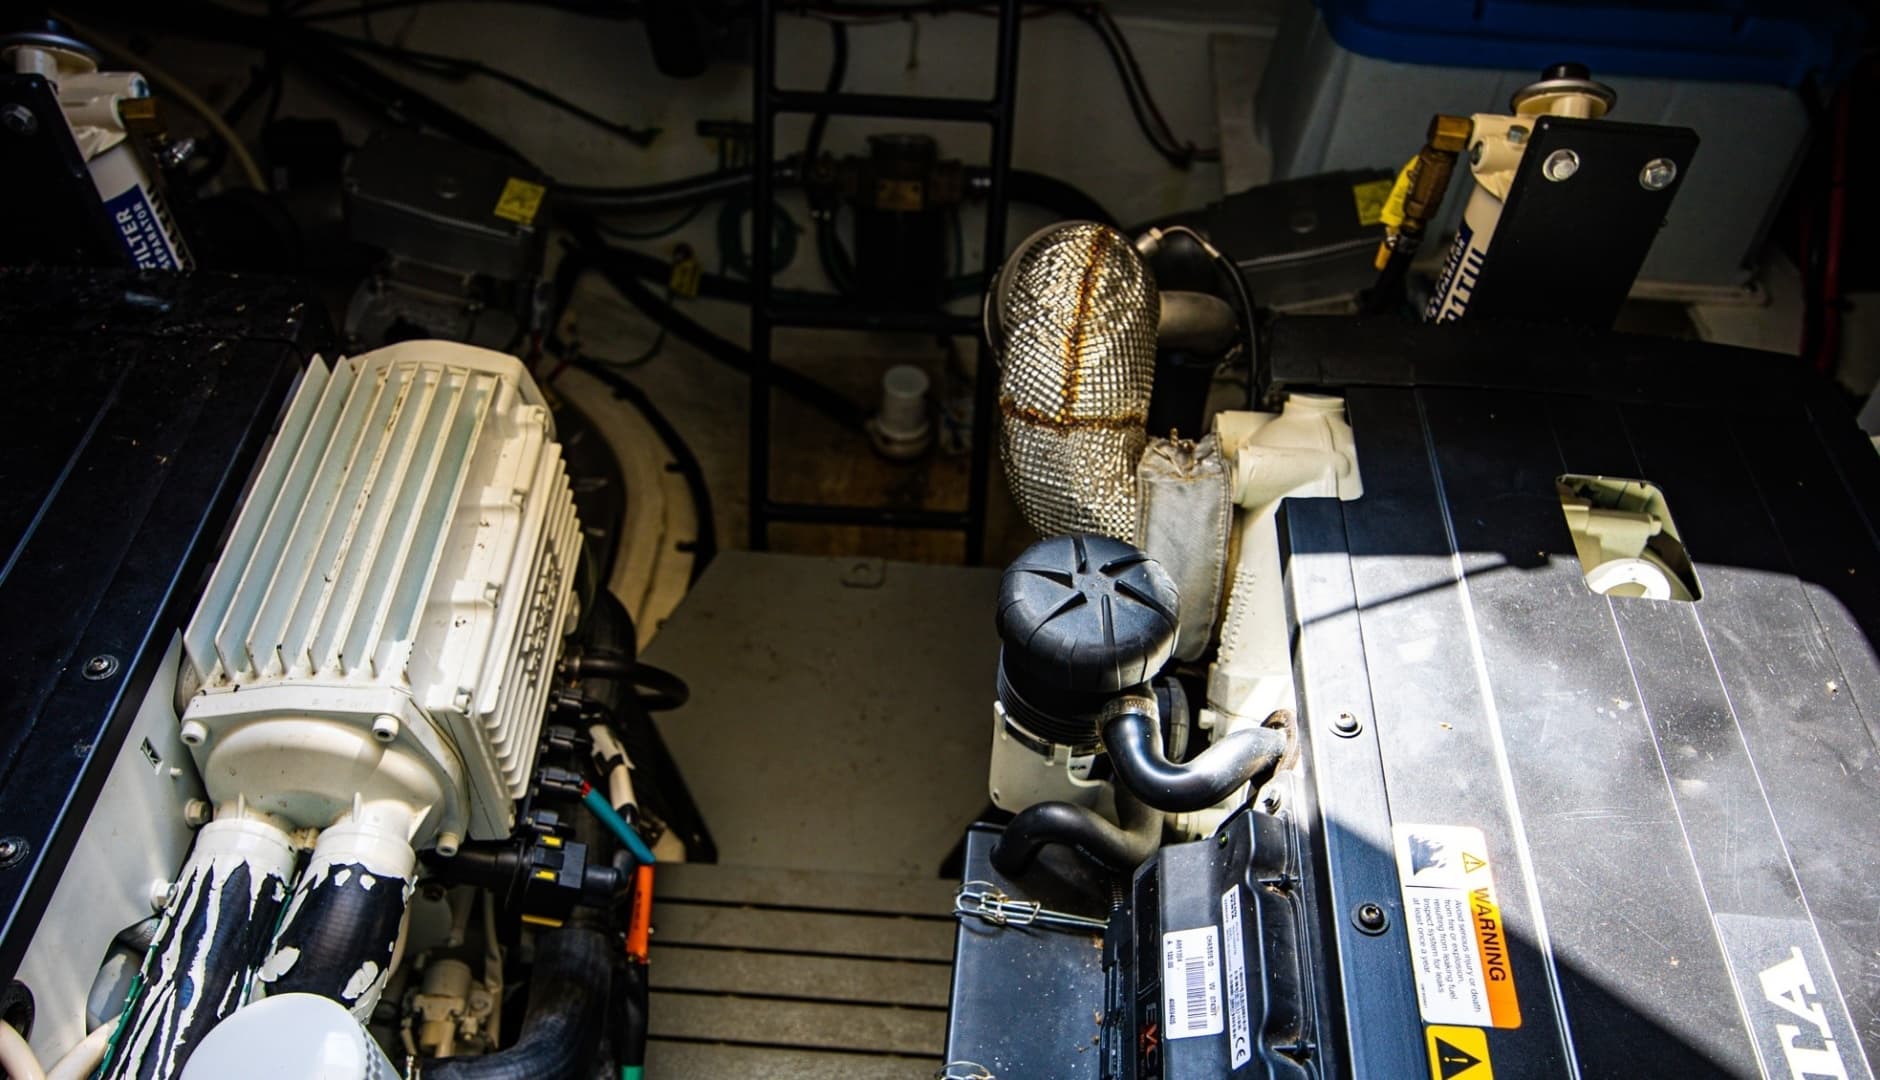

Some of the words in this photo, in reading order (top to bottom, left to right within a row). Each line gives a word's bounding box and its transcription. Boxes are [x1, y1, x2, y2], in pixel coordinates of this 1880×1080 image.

[116, 207, 156, 269] FILTER
[1415, 907, 1424, 925] least
[1423, 898, 1434, 926] Inspect
[1433, 899, 1444, 931] resulting
[1444, 899, 1453, 918] from
[1455, 900, 1465, 923] Avoid
[1417, 926, 1427, 947] once
[1447, 919, 1456, 931] fire
[1474, 887, 1506, 982] WARNING
[1428, 928, 1438, 957] system
[1440, 932, 1448, 951] from
[1458, 923, 1469, 952] serious
[1433, 958, 1441, 970] for
[1442, 953, 1453, 983] leaking
[1463, 955, 1474, 976] injury
[1468, 977, 1477, 987] or
[1470, 988, 1482, 1013] death
